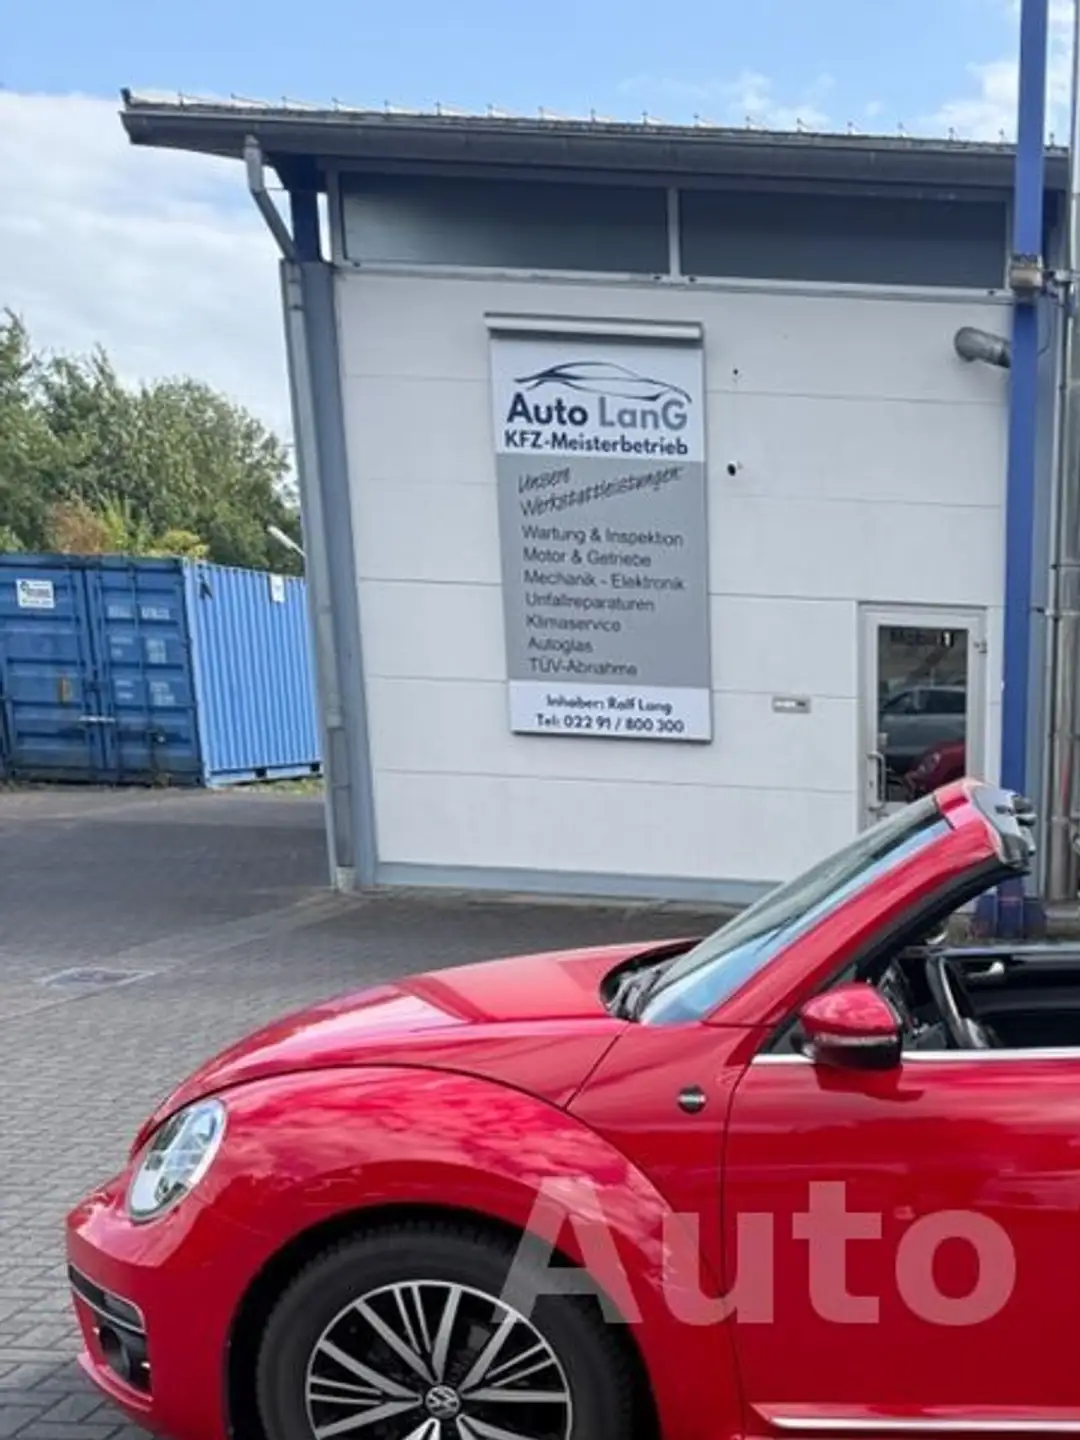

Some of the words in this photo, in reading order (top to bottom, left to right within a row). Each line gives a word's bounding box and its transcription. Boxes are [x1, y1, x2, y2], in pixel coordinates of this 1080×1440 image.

[506, 391, 589, 426] Auto
[598, 396, 688, 431] LanG
[504, 429, 688, 455] KFZ-Meisterbetrieb
[521, 524, 586, 545] Wartung
[590, 527, 601, 542] &
[605, 528, 684, 547] Inspektion
[523, 547, 566, 563] Motor
[571, 549, 582, 565] &
[587, 549, 651, 567] Getriebe
[523, 569, 596, 586] Mechanik
[611, 573, 684, 590] Elektronik
[525, 592, 655, 611] Unfallreparaturen
[526, 613, 621, 632] Klimaservice
[528, 636, 593, 655] Autoglas
[529, 655, 637, 676] TÜV-Abnahme
[564, 715, 593, 729] 022
